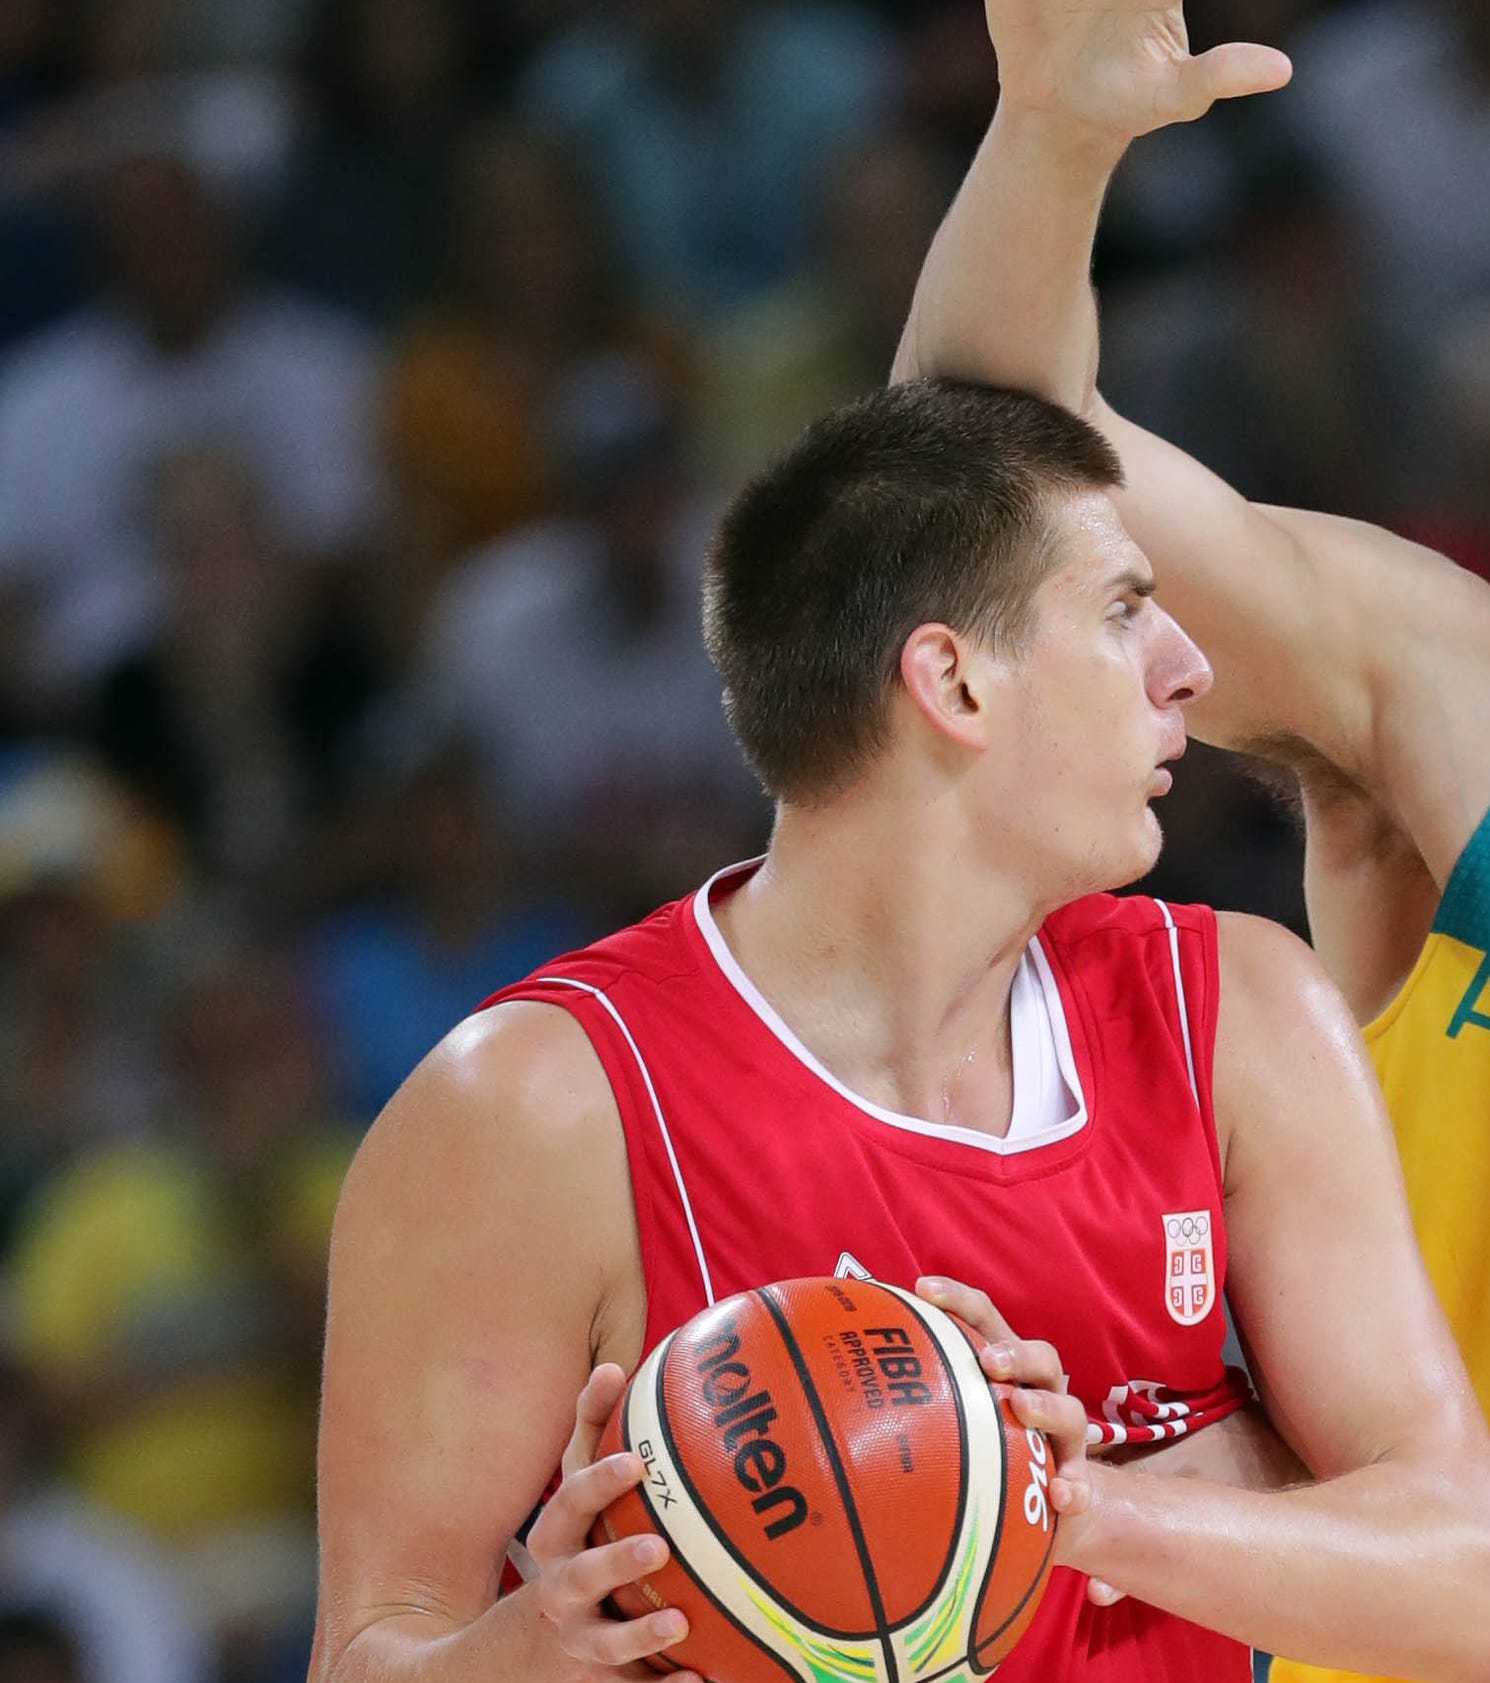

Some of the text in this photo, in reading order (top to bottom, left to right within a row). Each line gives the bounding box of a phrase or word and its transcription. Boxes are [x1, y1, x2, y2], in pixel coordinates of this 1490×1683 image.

[840, 1331, 884, 1409] APPROVED
[864, 1328, 932, 1407] FIBA
[694, 1318, 808, 1541] molten
[638, 1439, 678, 1509] GL7X
[1024, 1427, 1048, 1532] 016
